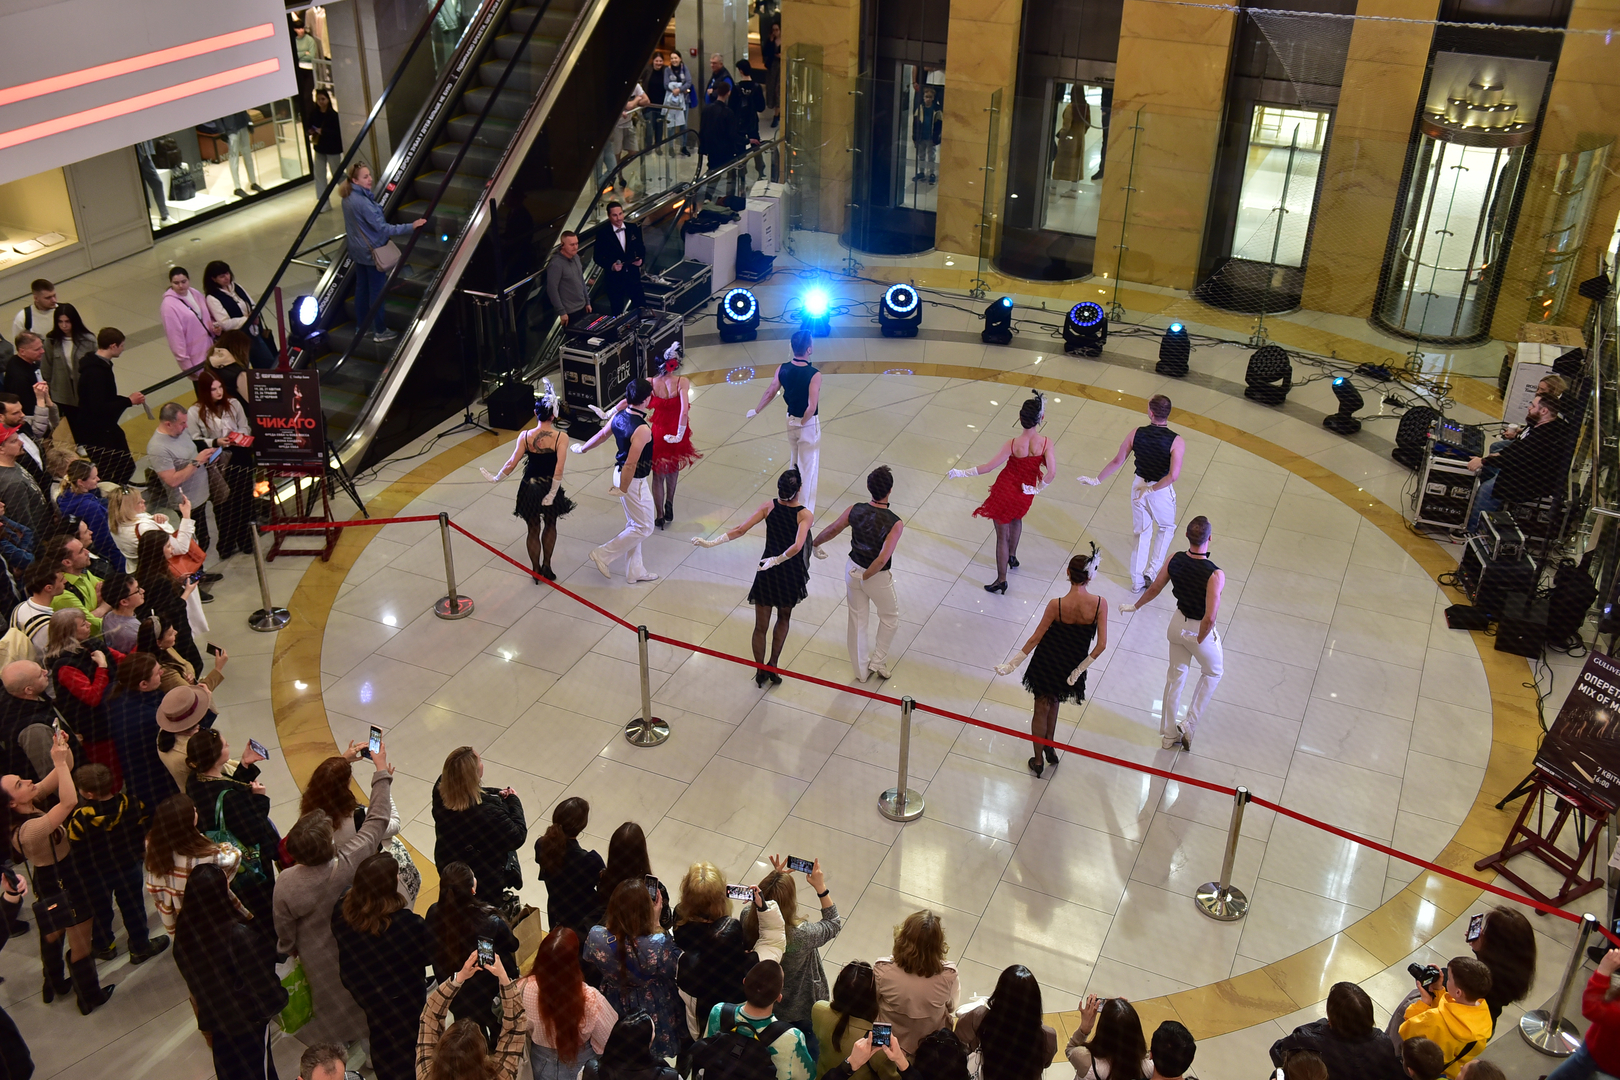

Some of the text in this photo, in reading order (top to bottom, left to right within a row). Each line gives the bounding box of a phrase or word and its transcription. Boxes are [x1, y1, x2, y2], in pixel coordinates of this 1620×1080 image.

[617, 367, 630, 384] LUX
[256, 417, 316, 429] ЧИКАГО
[1593, 657, 1620, 677] GULLIVE
[1578, 683, 1597, 698] MIX
[1596, 693, 1610, 705] OF
[1593, 774, 1610, 789] 16:00
